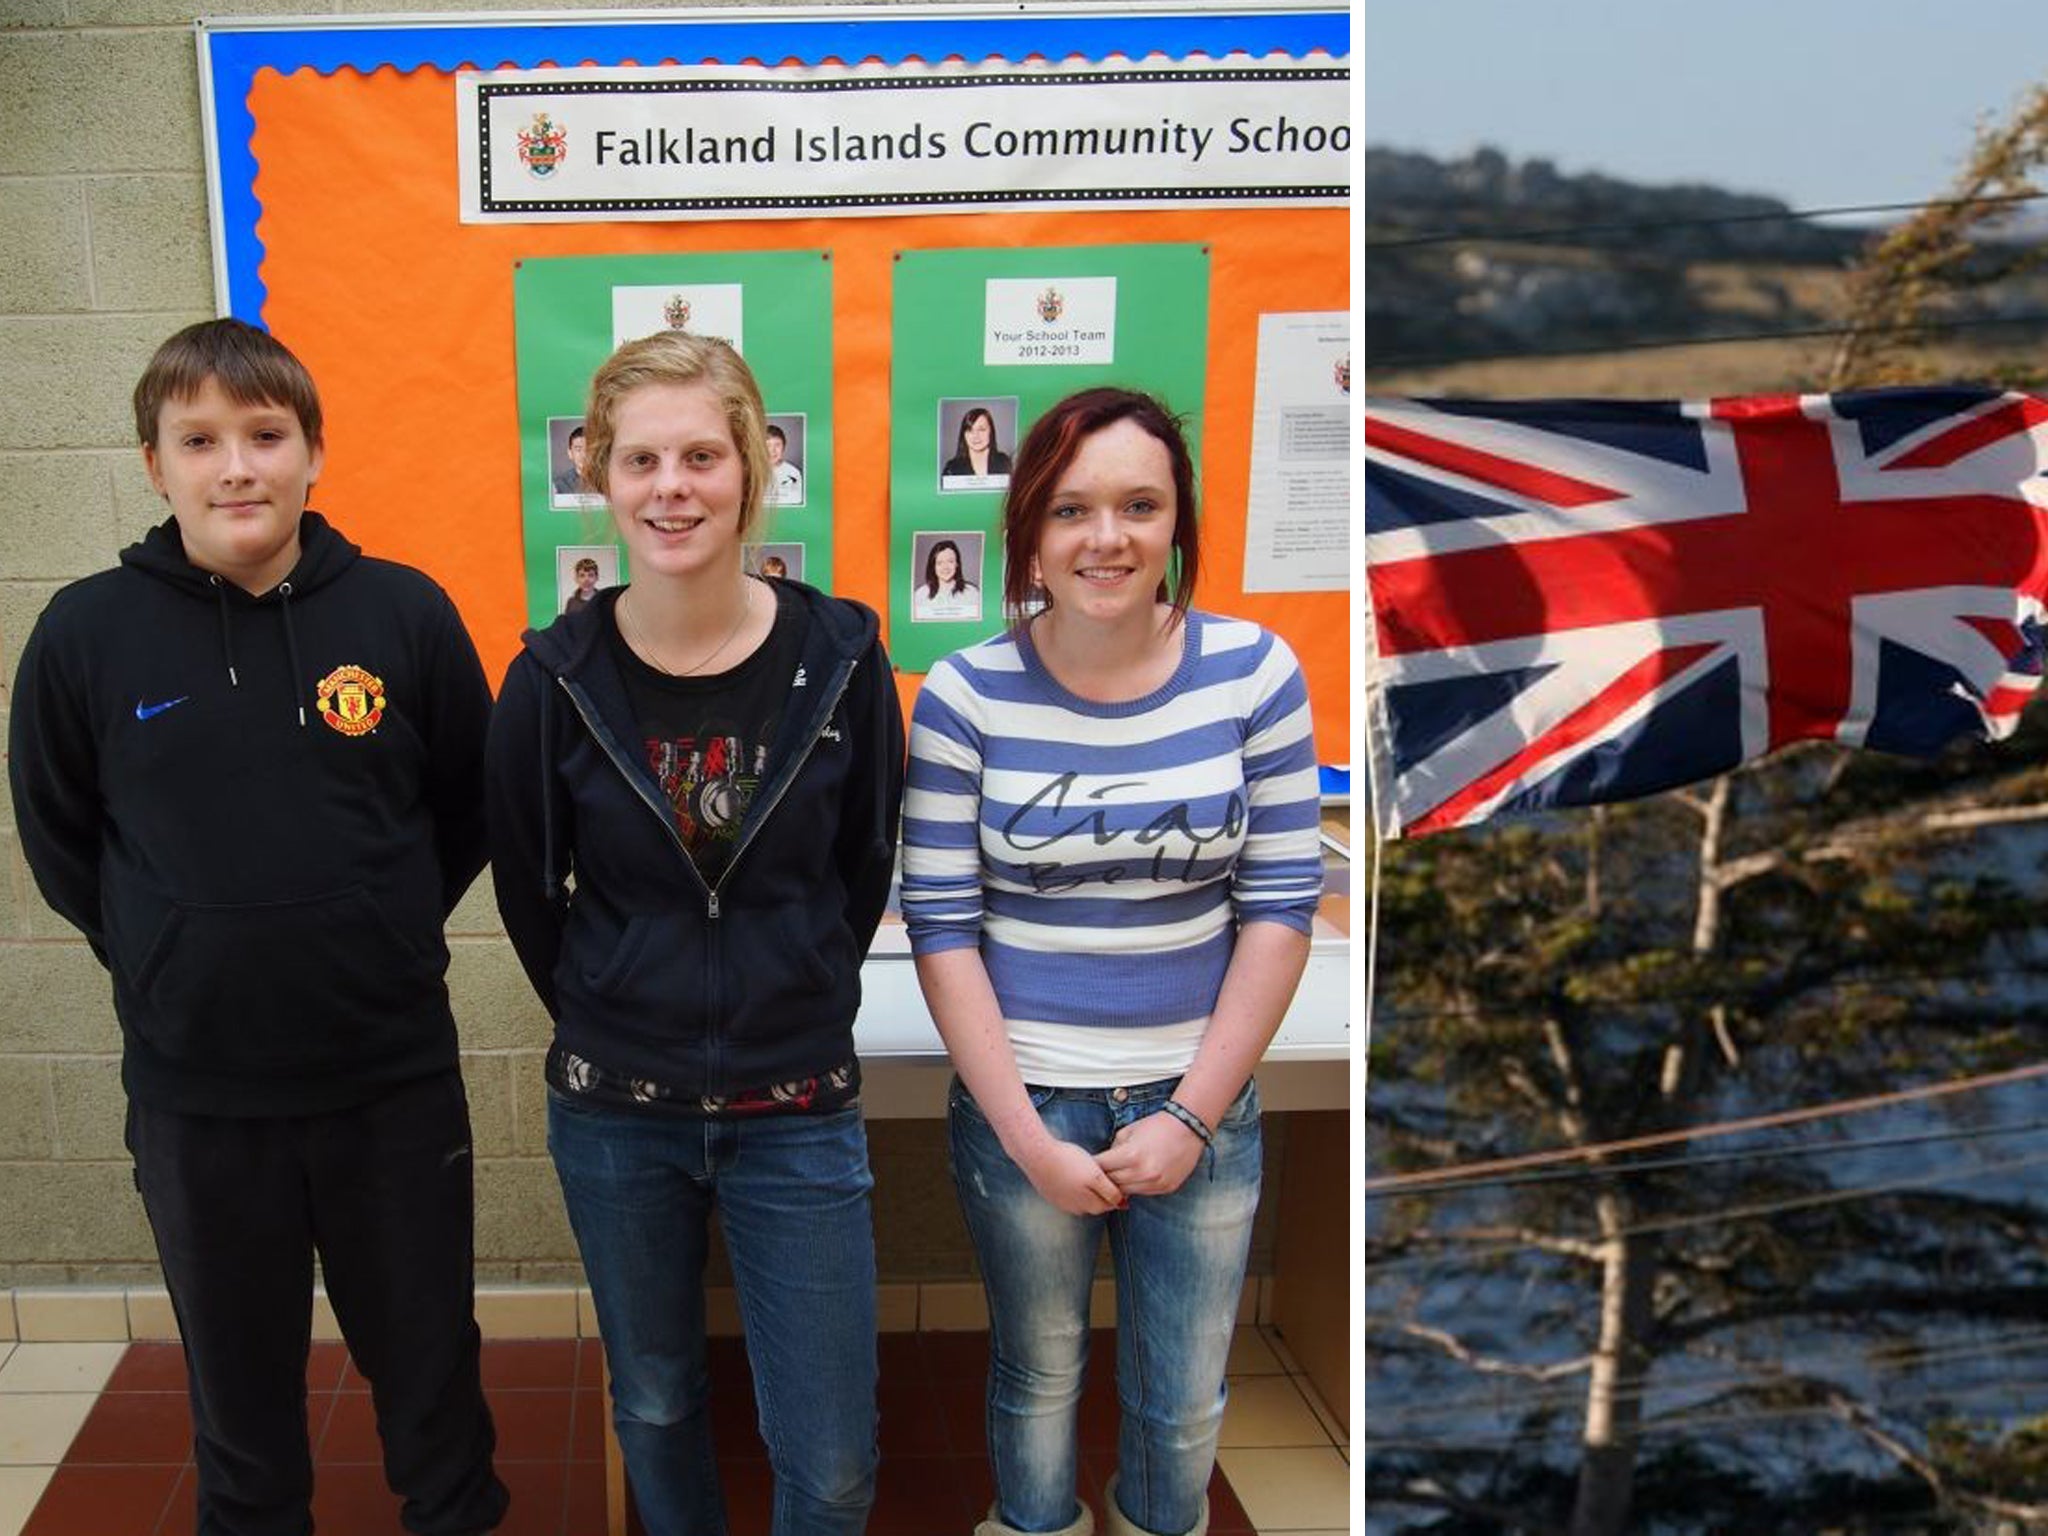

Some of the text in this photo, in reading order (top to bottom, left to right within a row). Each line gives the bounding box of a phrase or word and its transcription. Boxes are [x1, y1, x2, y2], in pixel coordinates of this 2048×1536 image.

[596, 126, 776, 165] Falkland
[795, 123, 946, 163] Islands
[964, 118, 1214, 161] Community
[994, 329, 1106, 342] Your School Team
[1019, 345, 1080, 357] 2012-2013
[321, 668, 380, 695] MANCHESTER
[335, 717, 374, 732] UNITED
[1002, 771, 1244, 851] Ciao
